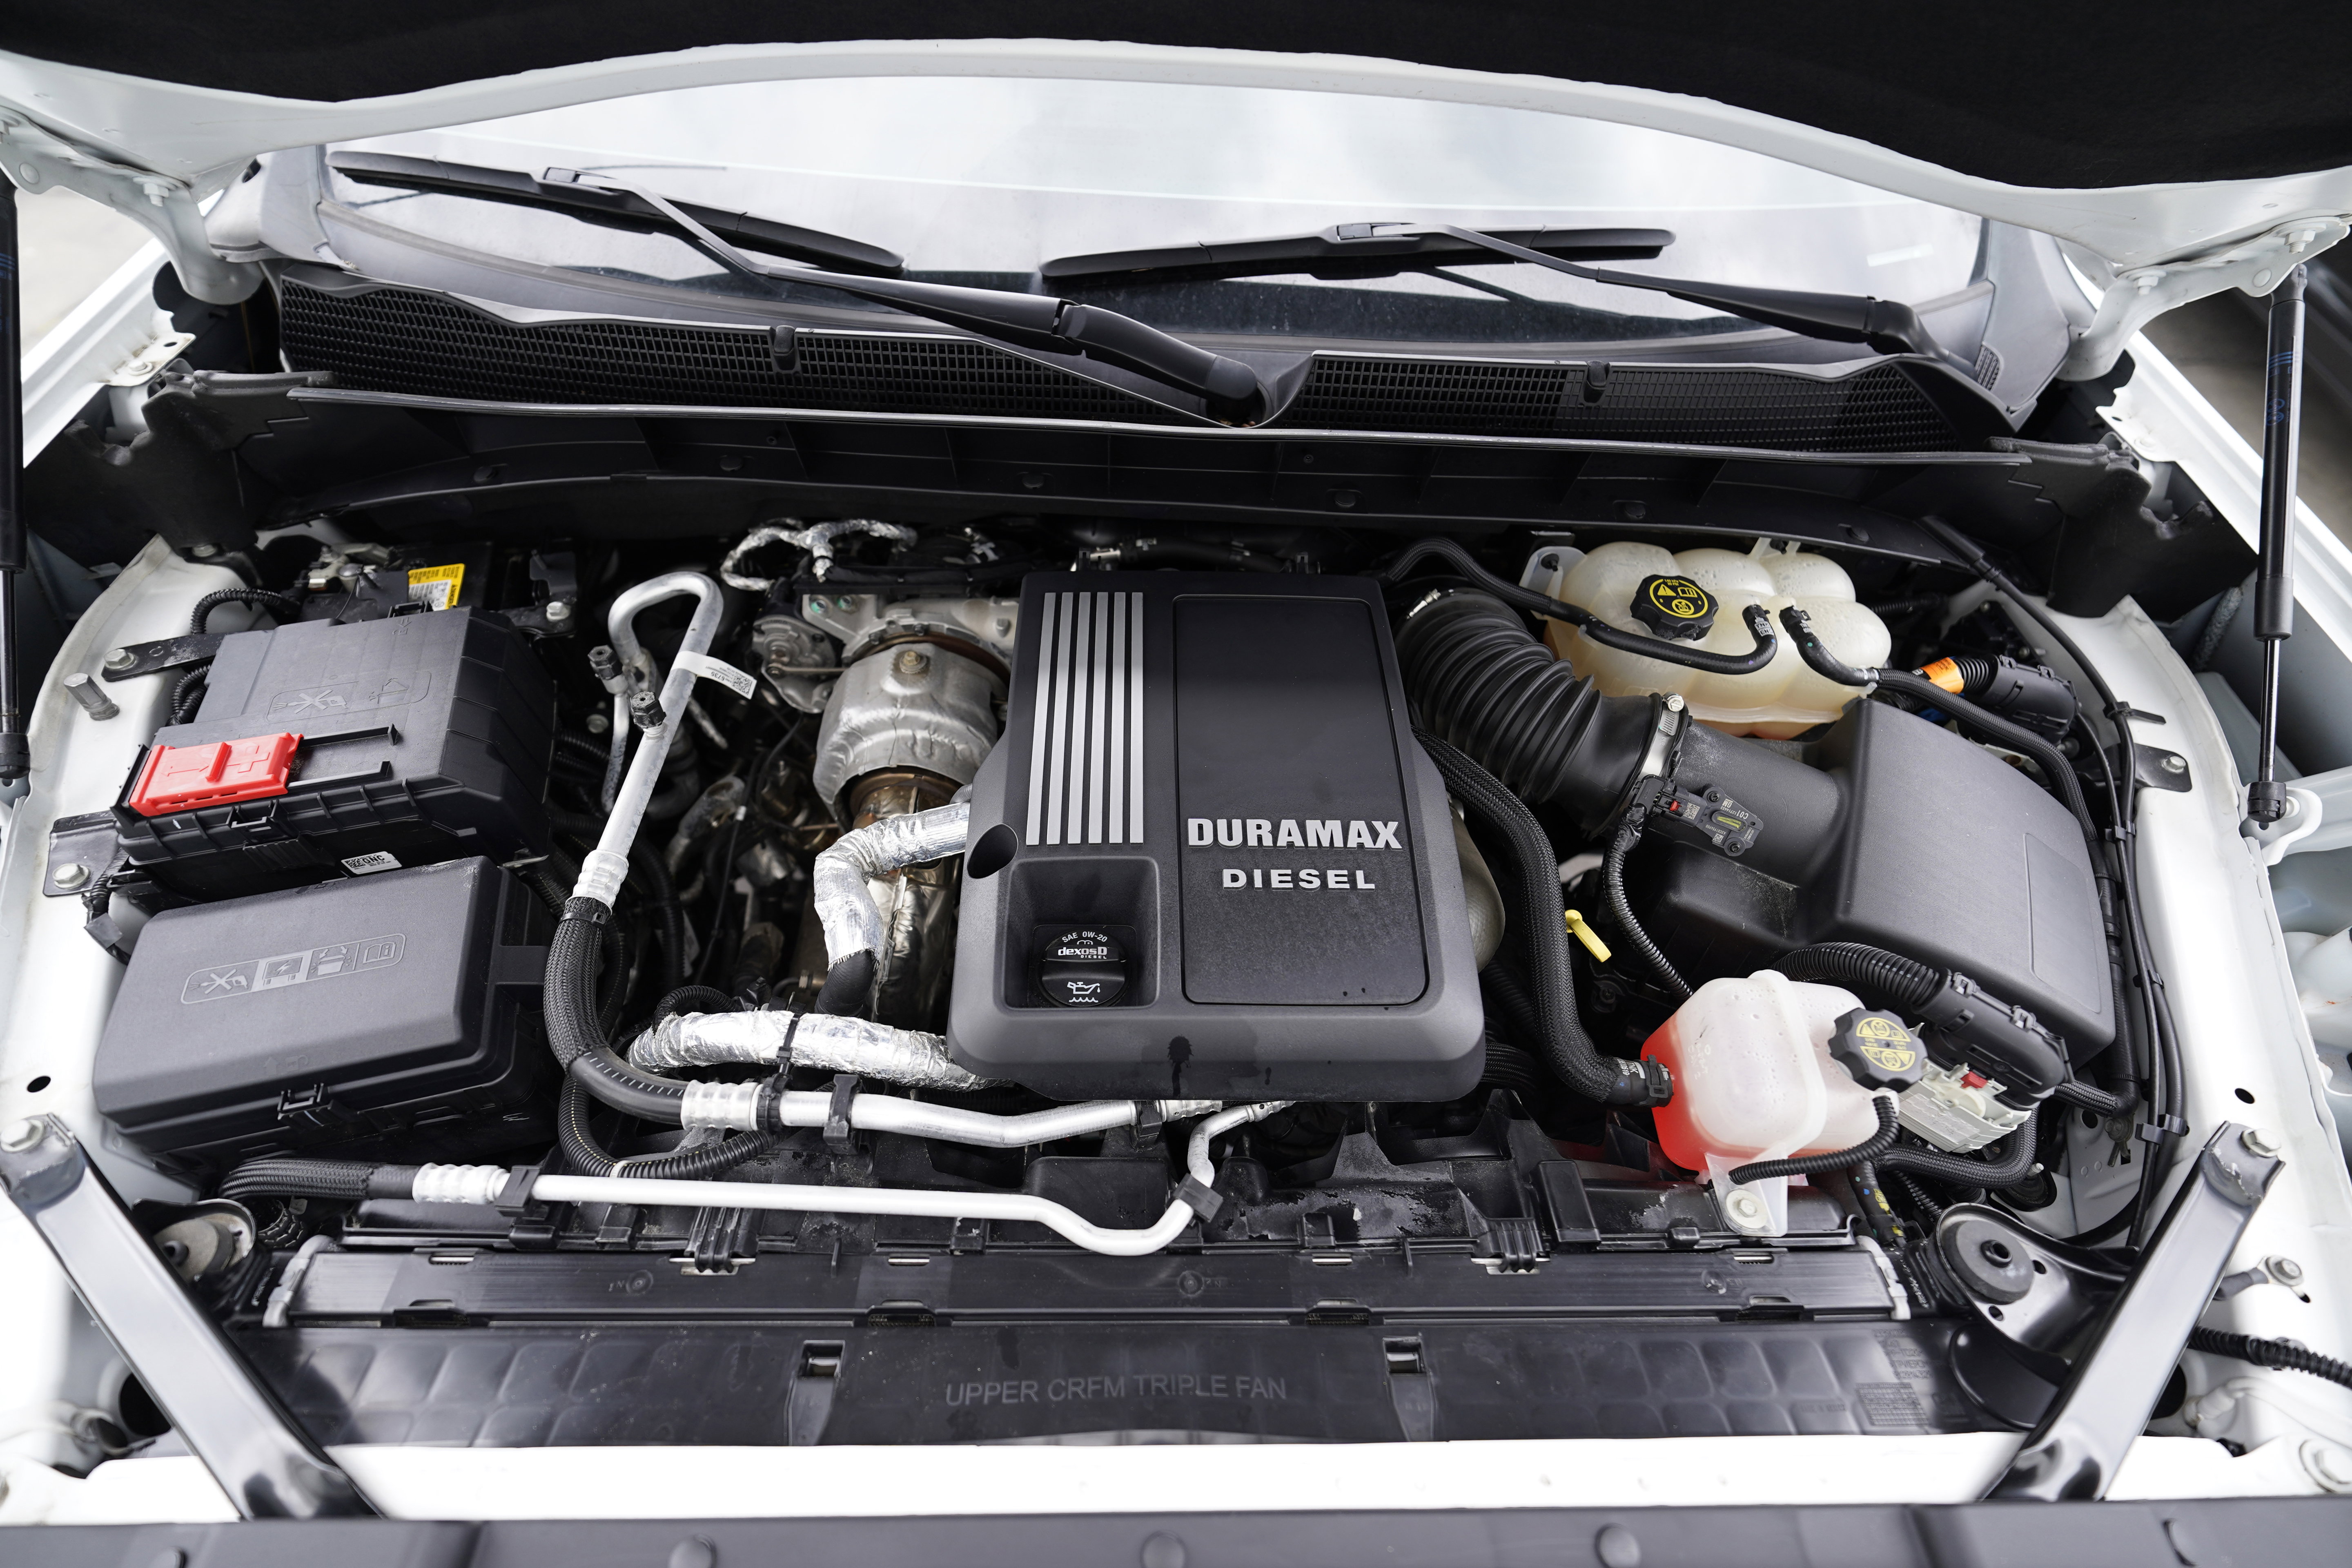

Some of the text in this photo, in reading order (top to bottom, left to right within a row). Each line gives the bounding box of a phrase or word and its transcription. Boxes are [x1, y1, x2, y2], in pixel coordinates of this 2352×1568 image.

[1722, 800, 1732, 808] GM
[1736, 809, 1749, 820] C01
[1187, 818, 1403, 850] DURAMAX
[363, 855, 385, 864] GNC
[1222, 869, 1375, 891] DIESEL
[1062, 931, 1107, 942] SAE 0W-20
[945, 1374, 1287, 1407] UPPER CRFM TRIPLE FAN
